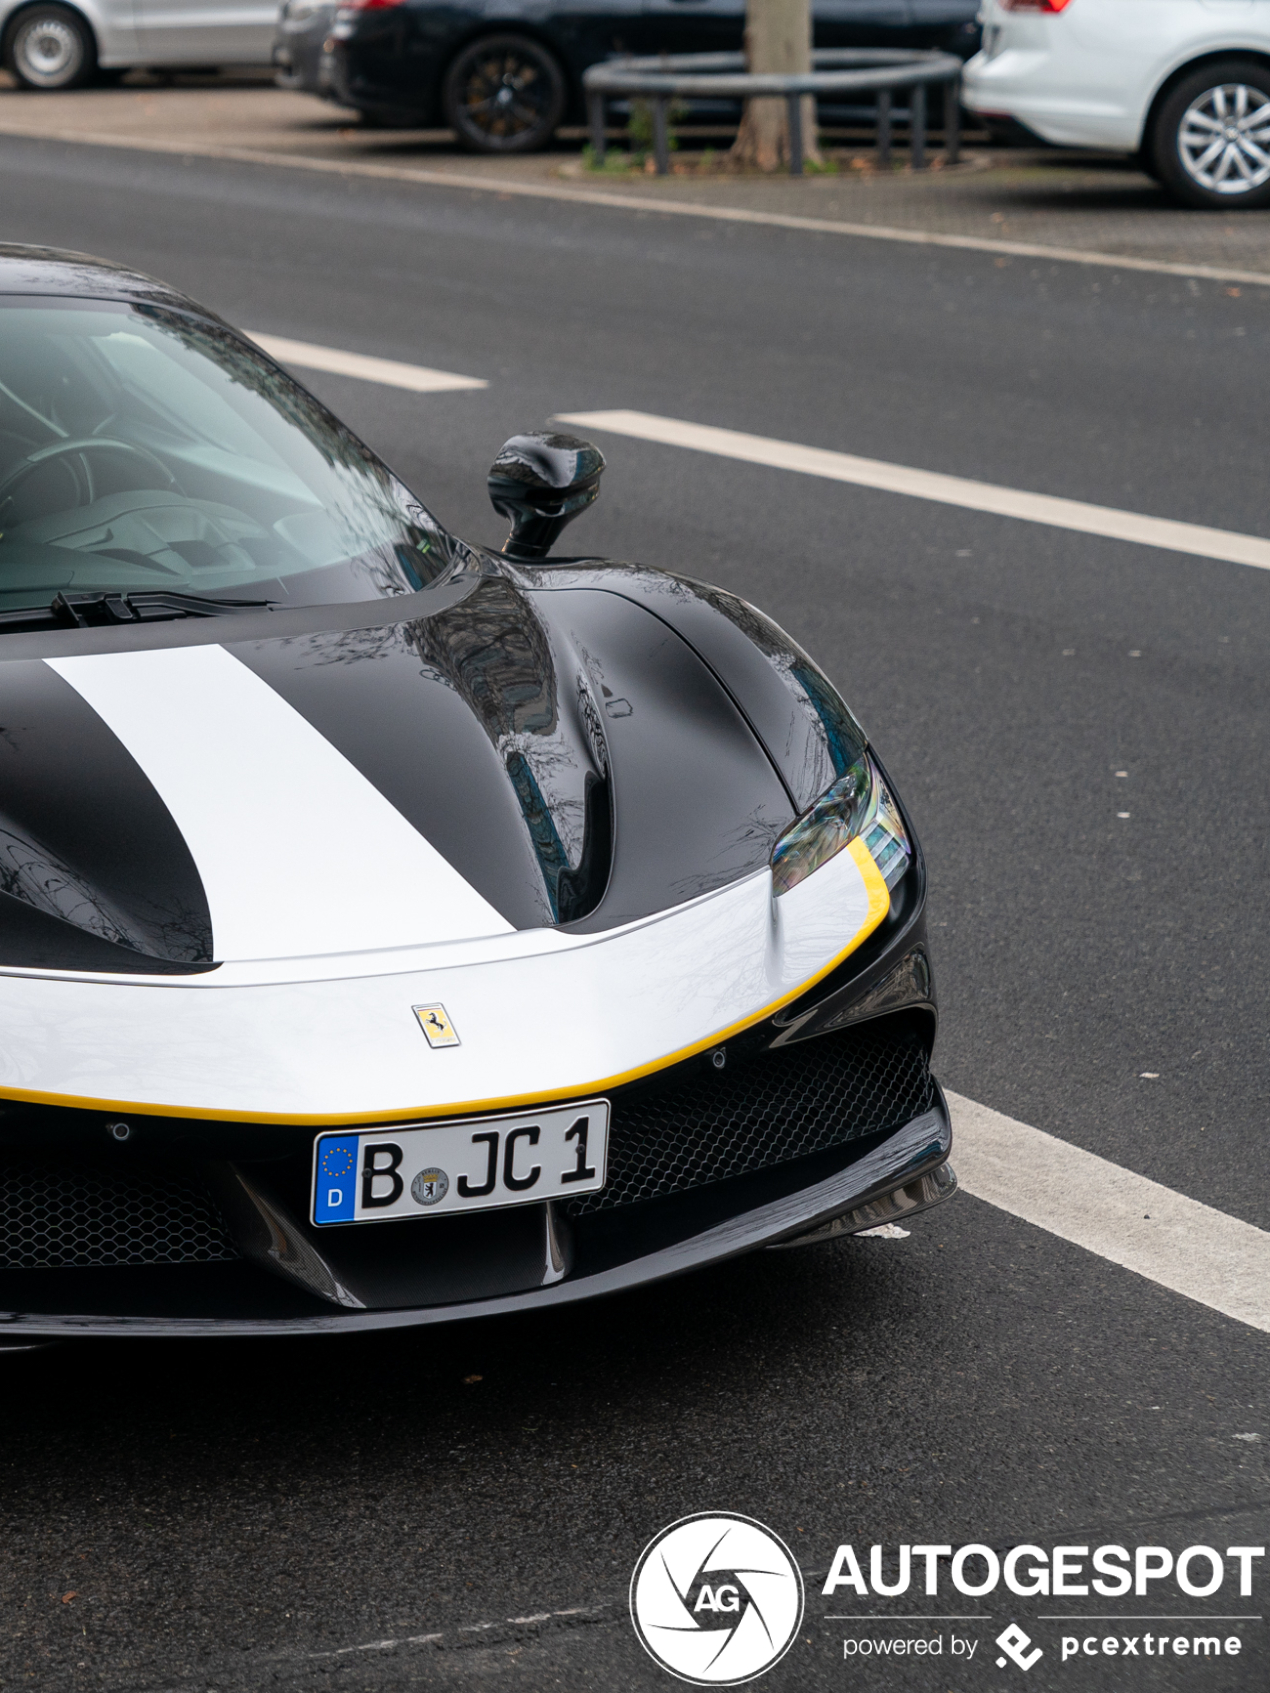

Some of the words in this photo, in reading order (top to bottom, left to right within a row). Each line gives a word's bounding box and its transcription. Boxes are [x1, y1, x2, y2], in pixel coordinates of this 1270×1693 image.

[361, 1142, 404, 1209] B
[456, 1124, 541, 1199] JC
[561, 1114, 596, 1185] 1
[327, 1188, 343, 1208] D
